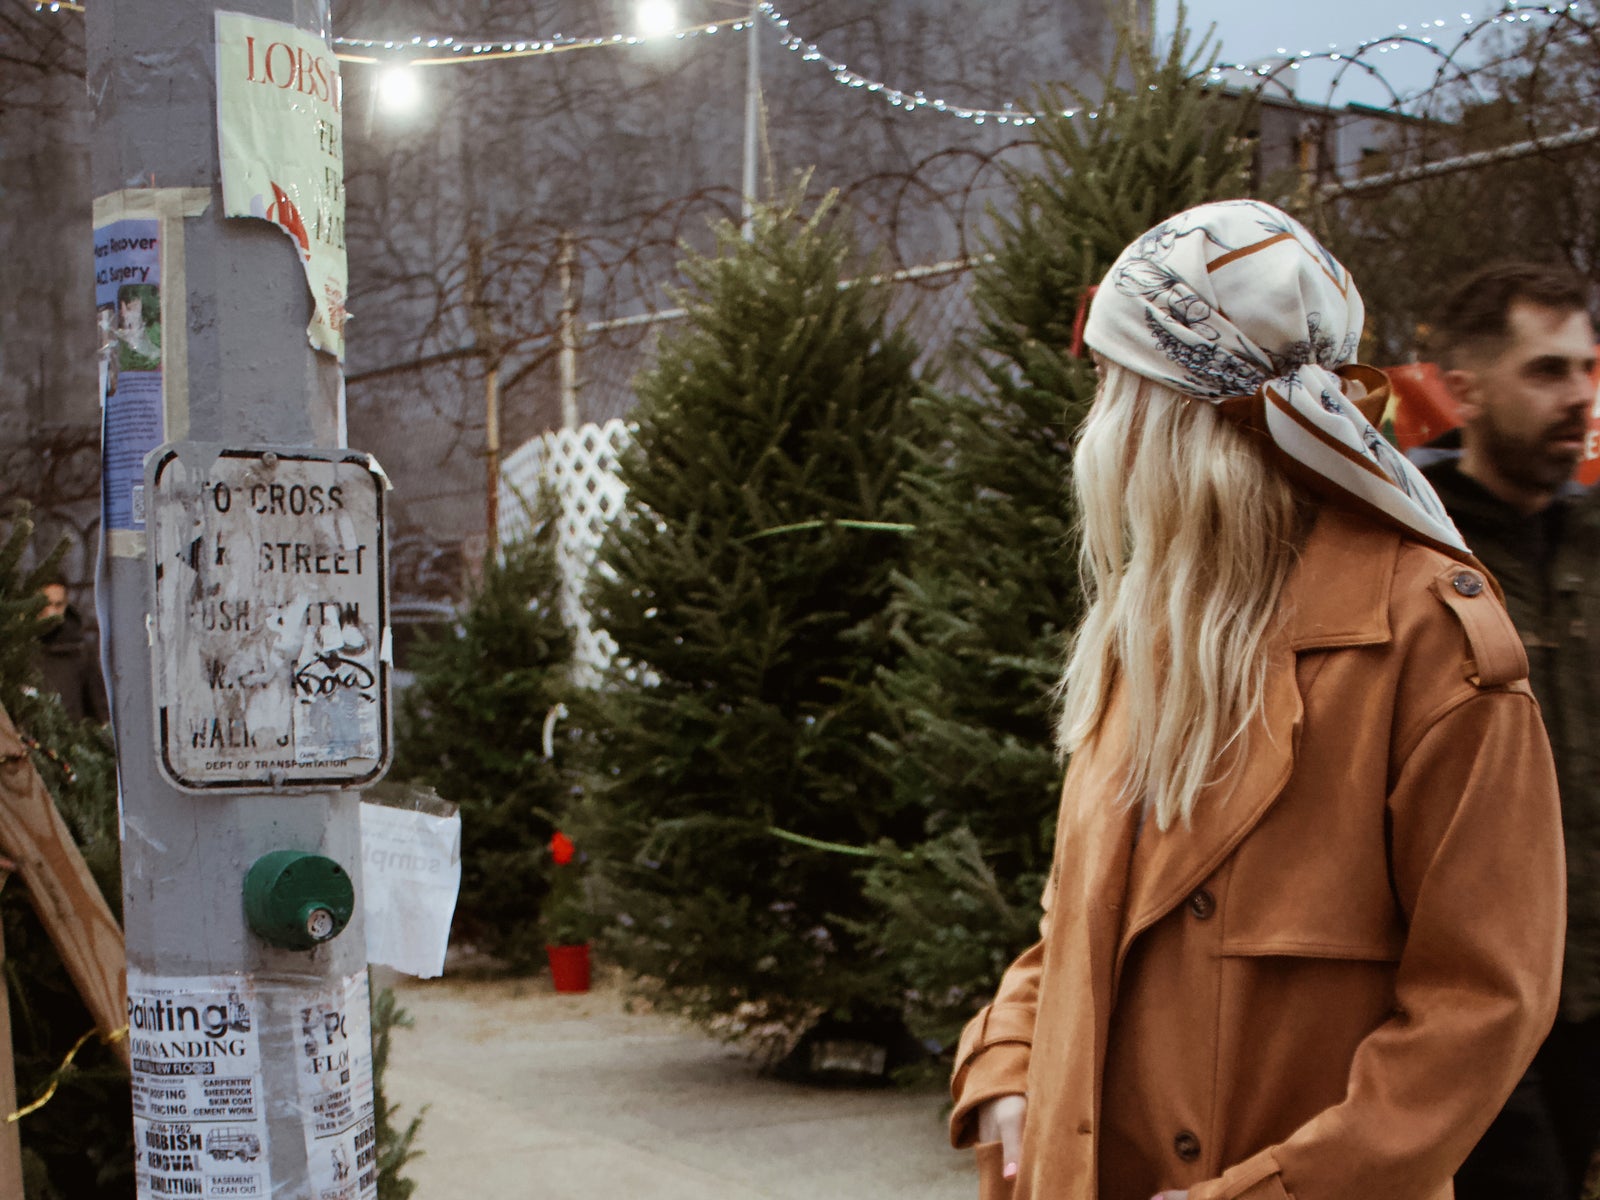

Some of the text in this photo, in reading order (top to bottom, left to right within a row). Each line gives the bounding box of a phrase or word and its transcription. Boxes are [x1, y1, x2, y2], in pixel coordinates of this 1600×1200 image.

[251, 484, 344, 515] CROSS
[259, 542, 367, 574] STREET
[191, 600, 250, 631] USH
[206, 761, 233, 770] DEPT
[237, 761, 250, 770] OF
[203, 1079, 252, 1088] CARPENTRY
[204, 1088, 252, 1097] SHEETROCK
[209, 1097, 252, 1106] SKIM COAT
[193, 1106, 254, 1117] CEMENT WORK
[211, 1176, 255, 1185] BASEMENT
